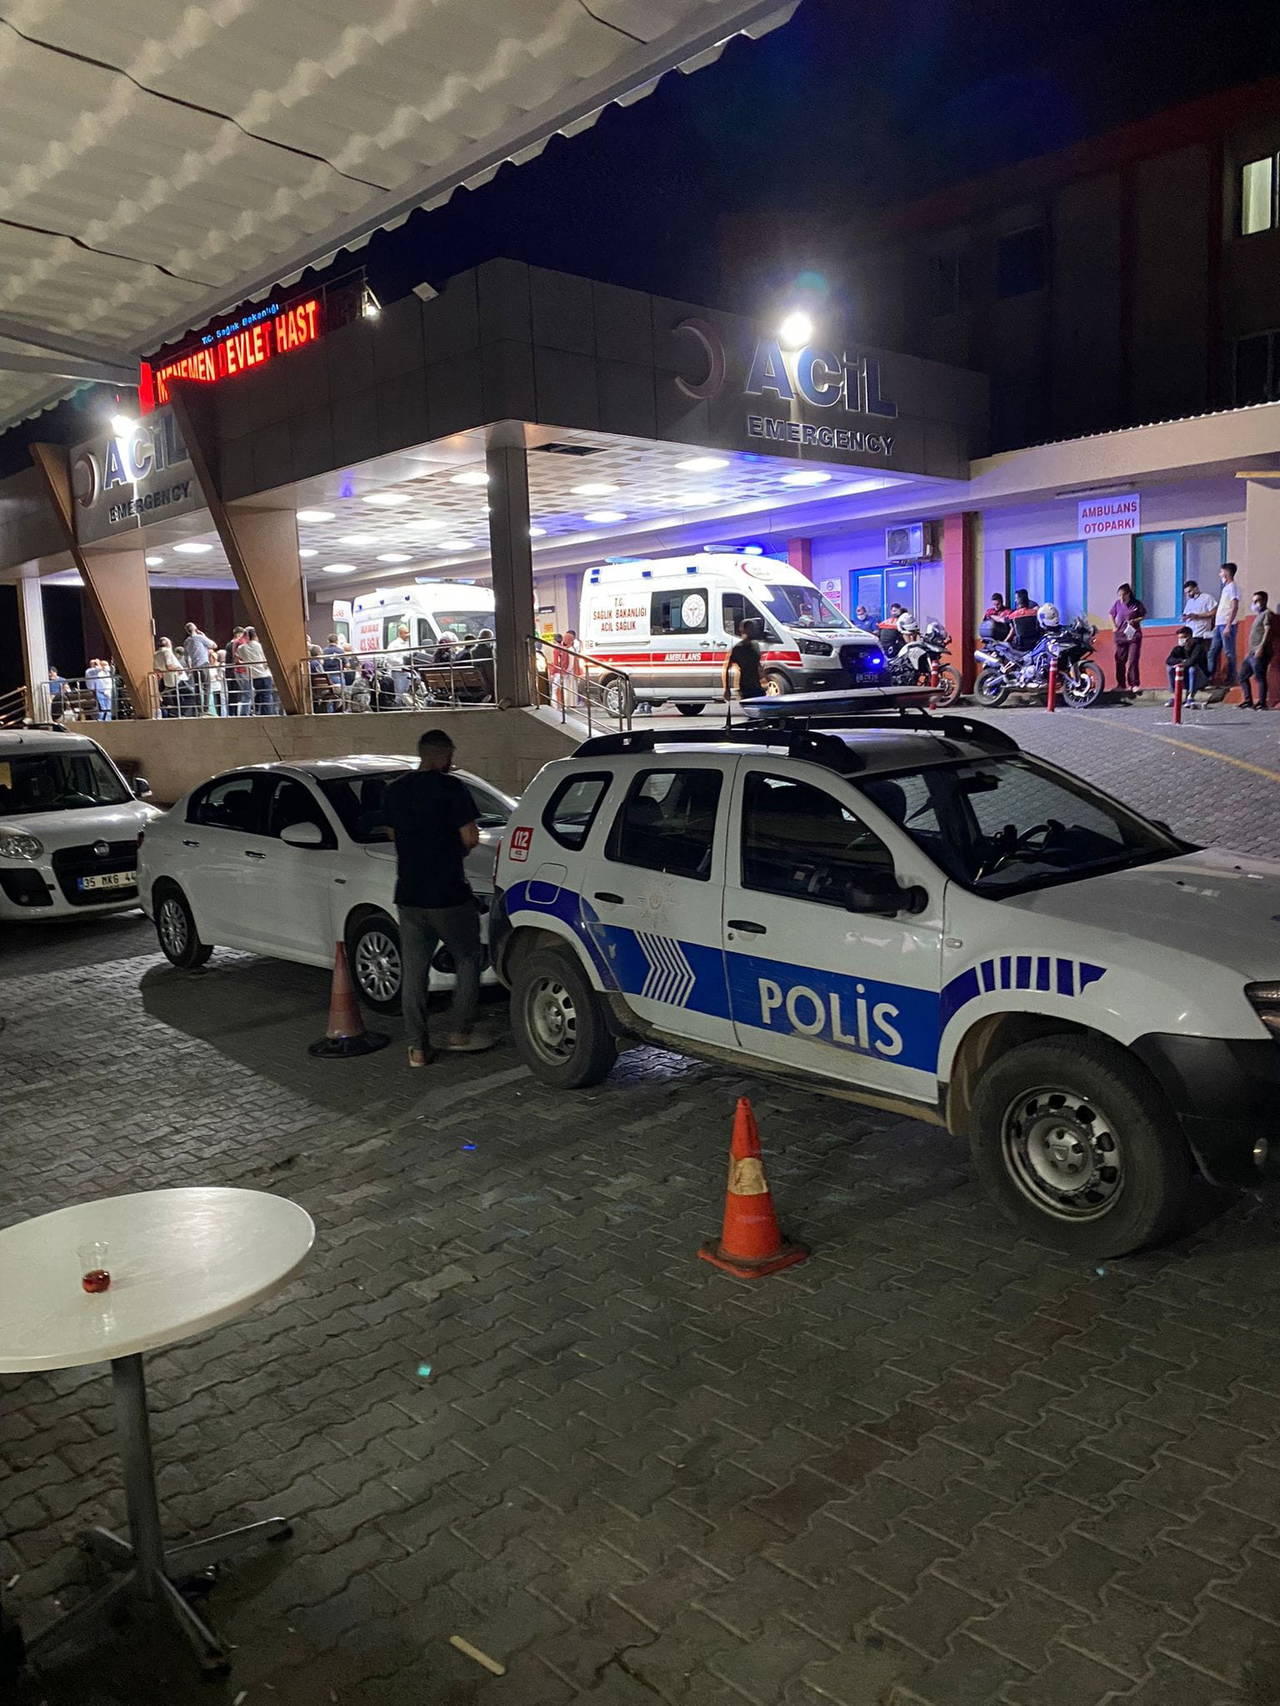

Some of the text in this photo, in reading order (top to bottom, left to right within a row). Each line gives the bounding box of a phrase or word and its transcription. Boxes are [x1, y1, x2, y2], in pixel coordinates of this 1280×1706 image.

[218, 321, 272, 377] DEVLET
[276, 300, 317, 353] HAST
[747, 415, 897, 457] EMERGENCY
[109, 480, 190, 524] EMERGENCY
[1081, 501, 1138, 518] AMBULANS
[1084, 518, 1136, 534] OTOPARKI
[665, 652, 702, 662] AMBULANS
[514, 830, 530, 848] 112
[84, 877, 96, 888] 35
[758, 977, 904, 1057] POLİS
